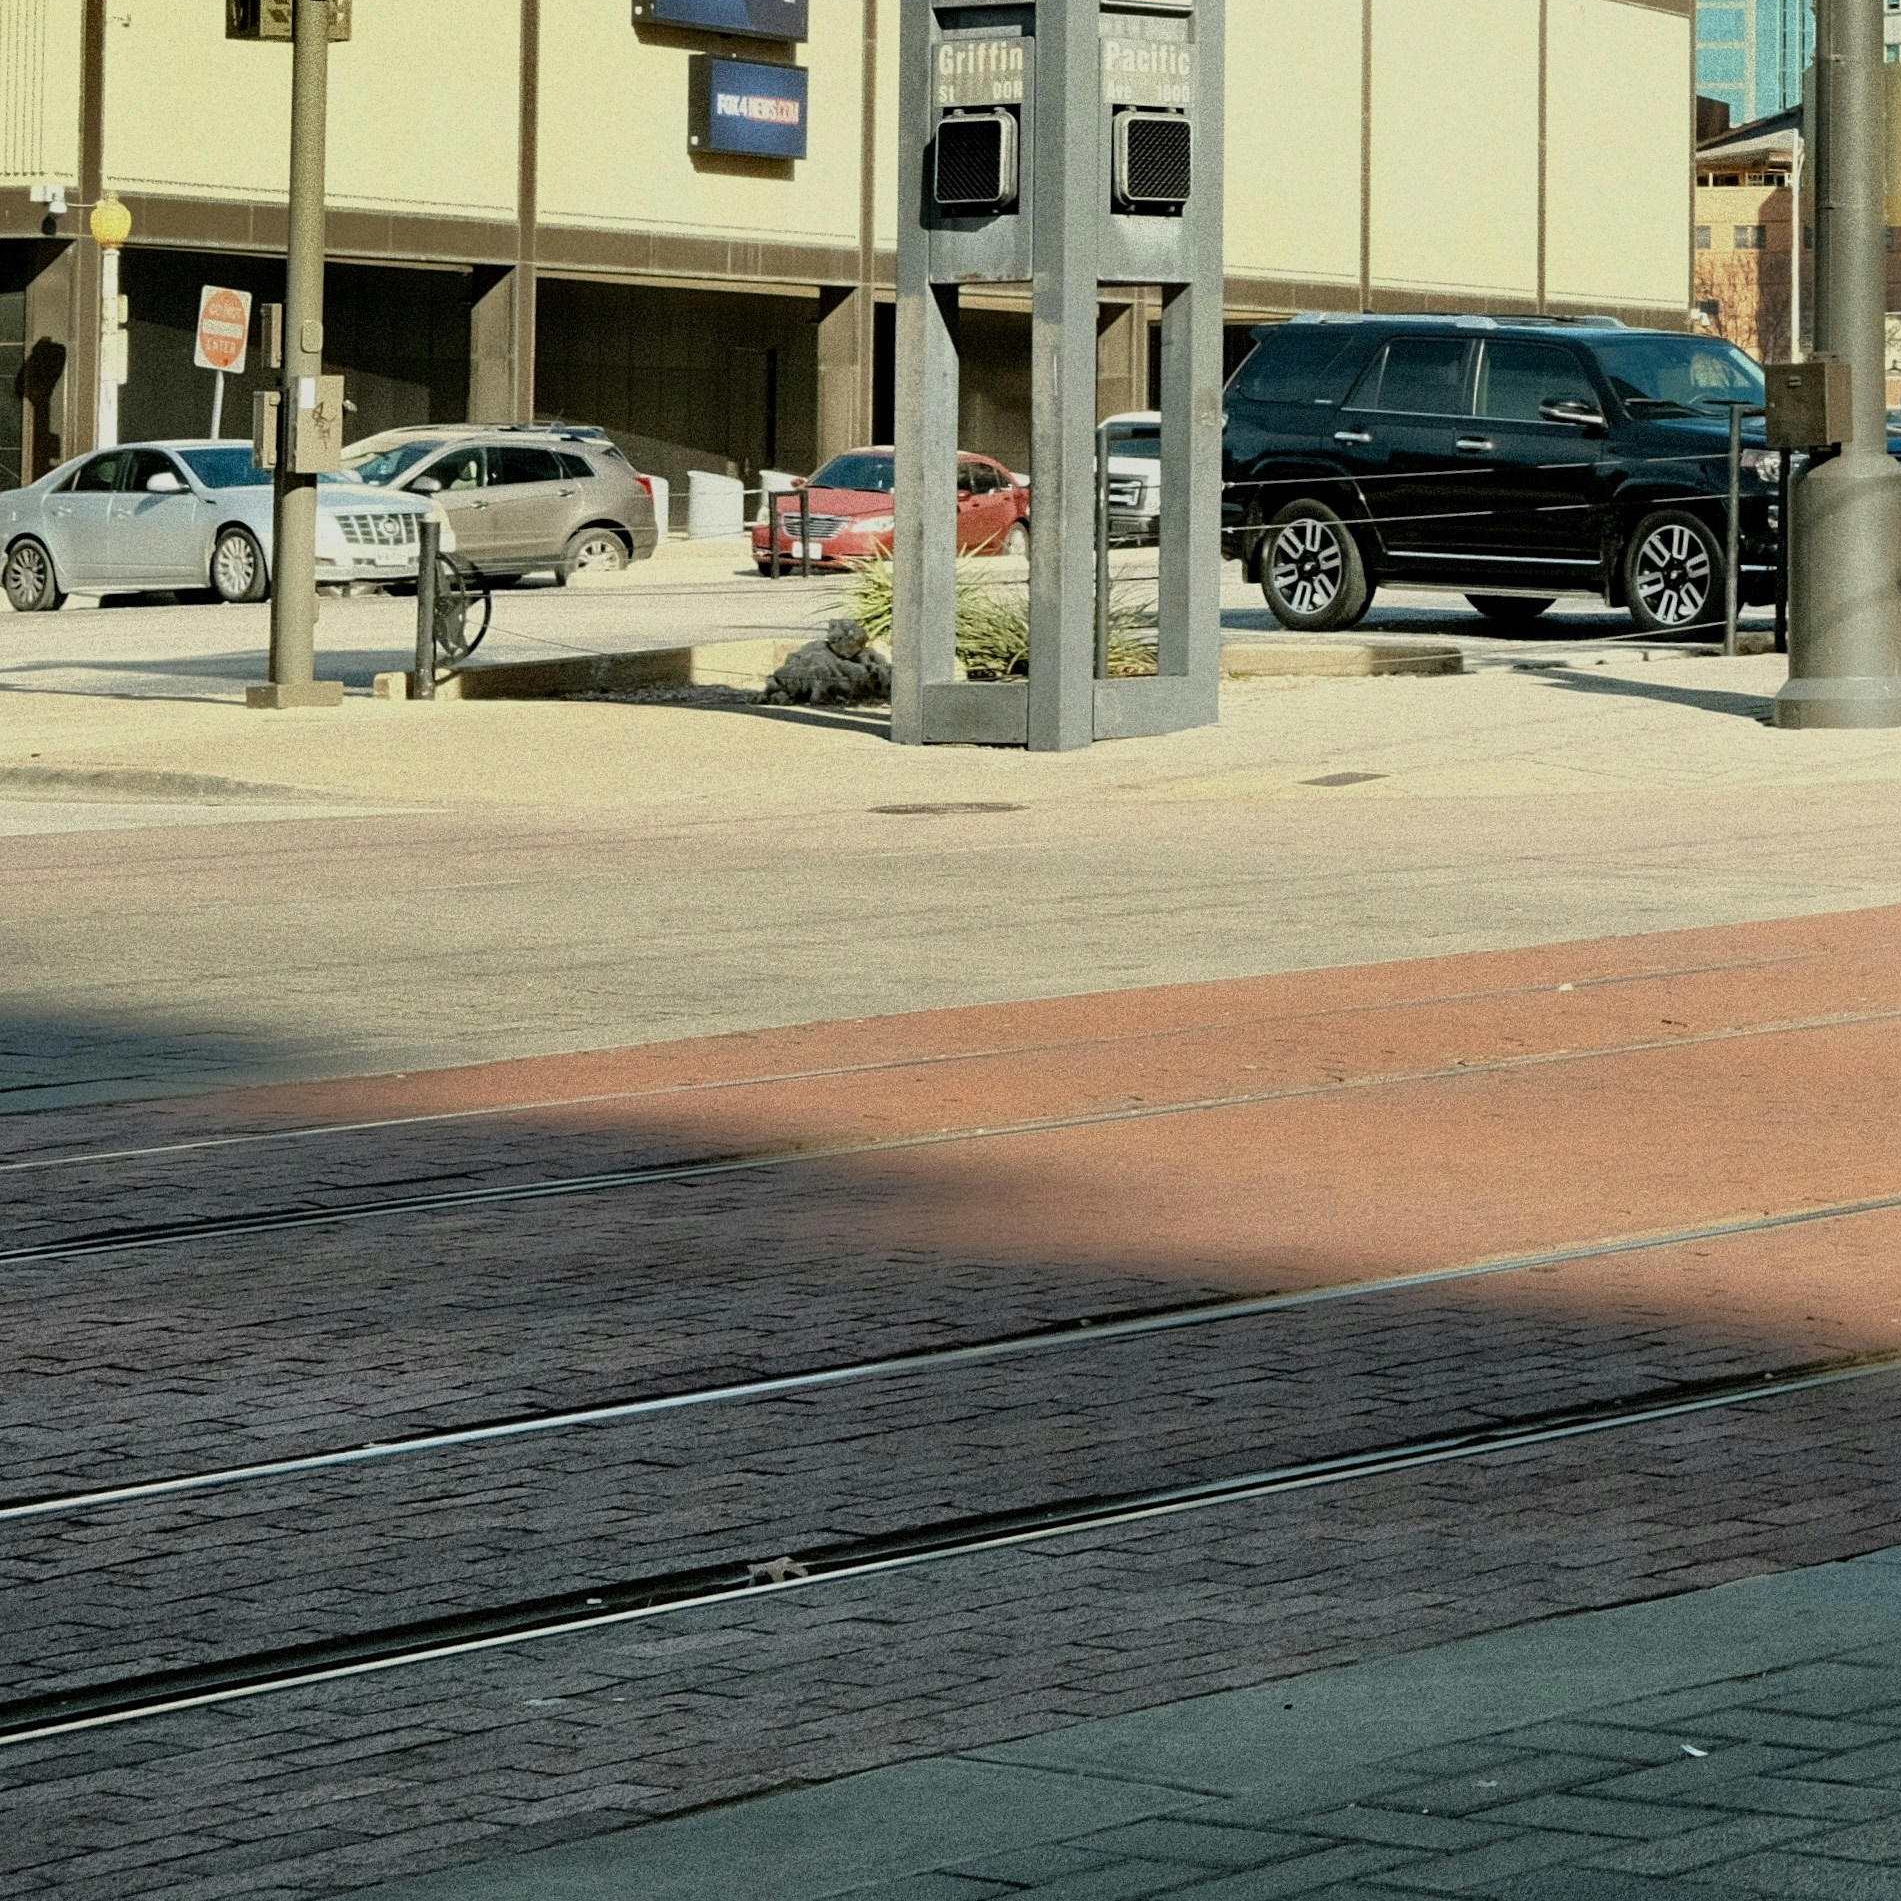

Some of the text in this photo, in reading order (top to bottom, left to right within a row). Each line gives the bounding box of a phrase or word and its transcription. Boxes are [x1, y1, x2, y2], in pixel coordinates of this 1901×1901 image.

[938, 41, 1023, 75] Griffin
[1105, 40, 1190, 76] Pacific
[938, 84, 954, 103] St
[1106, 79, 1133, 100] Ave
